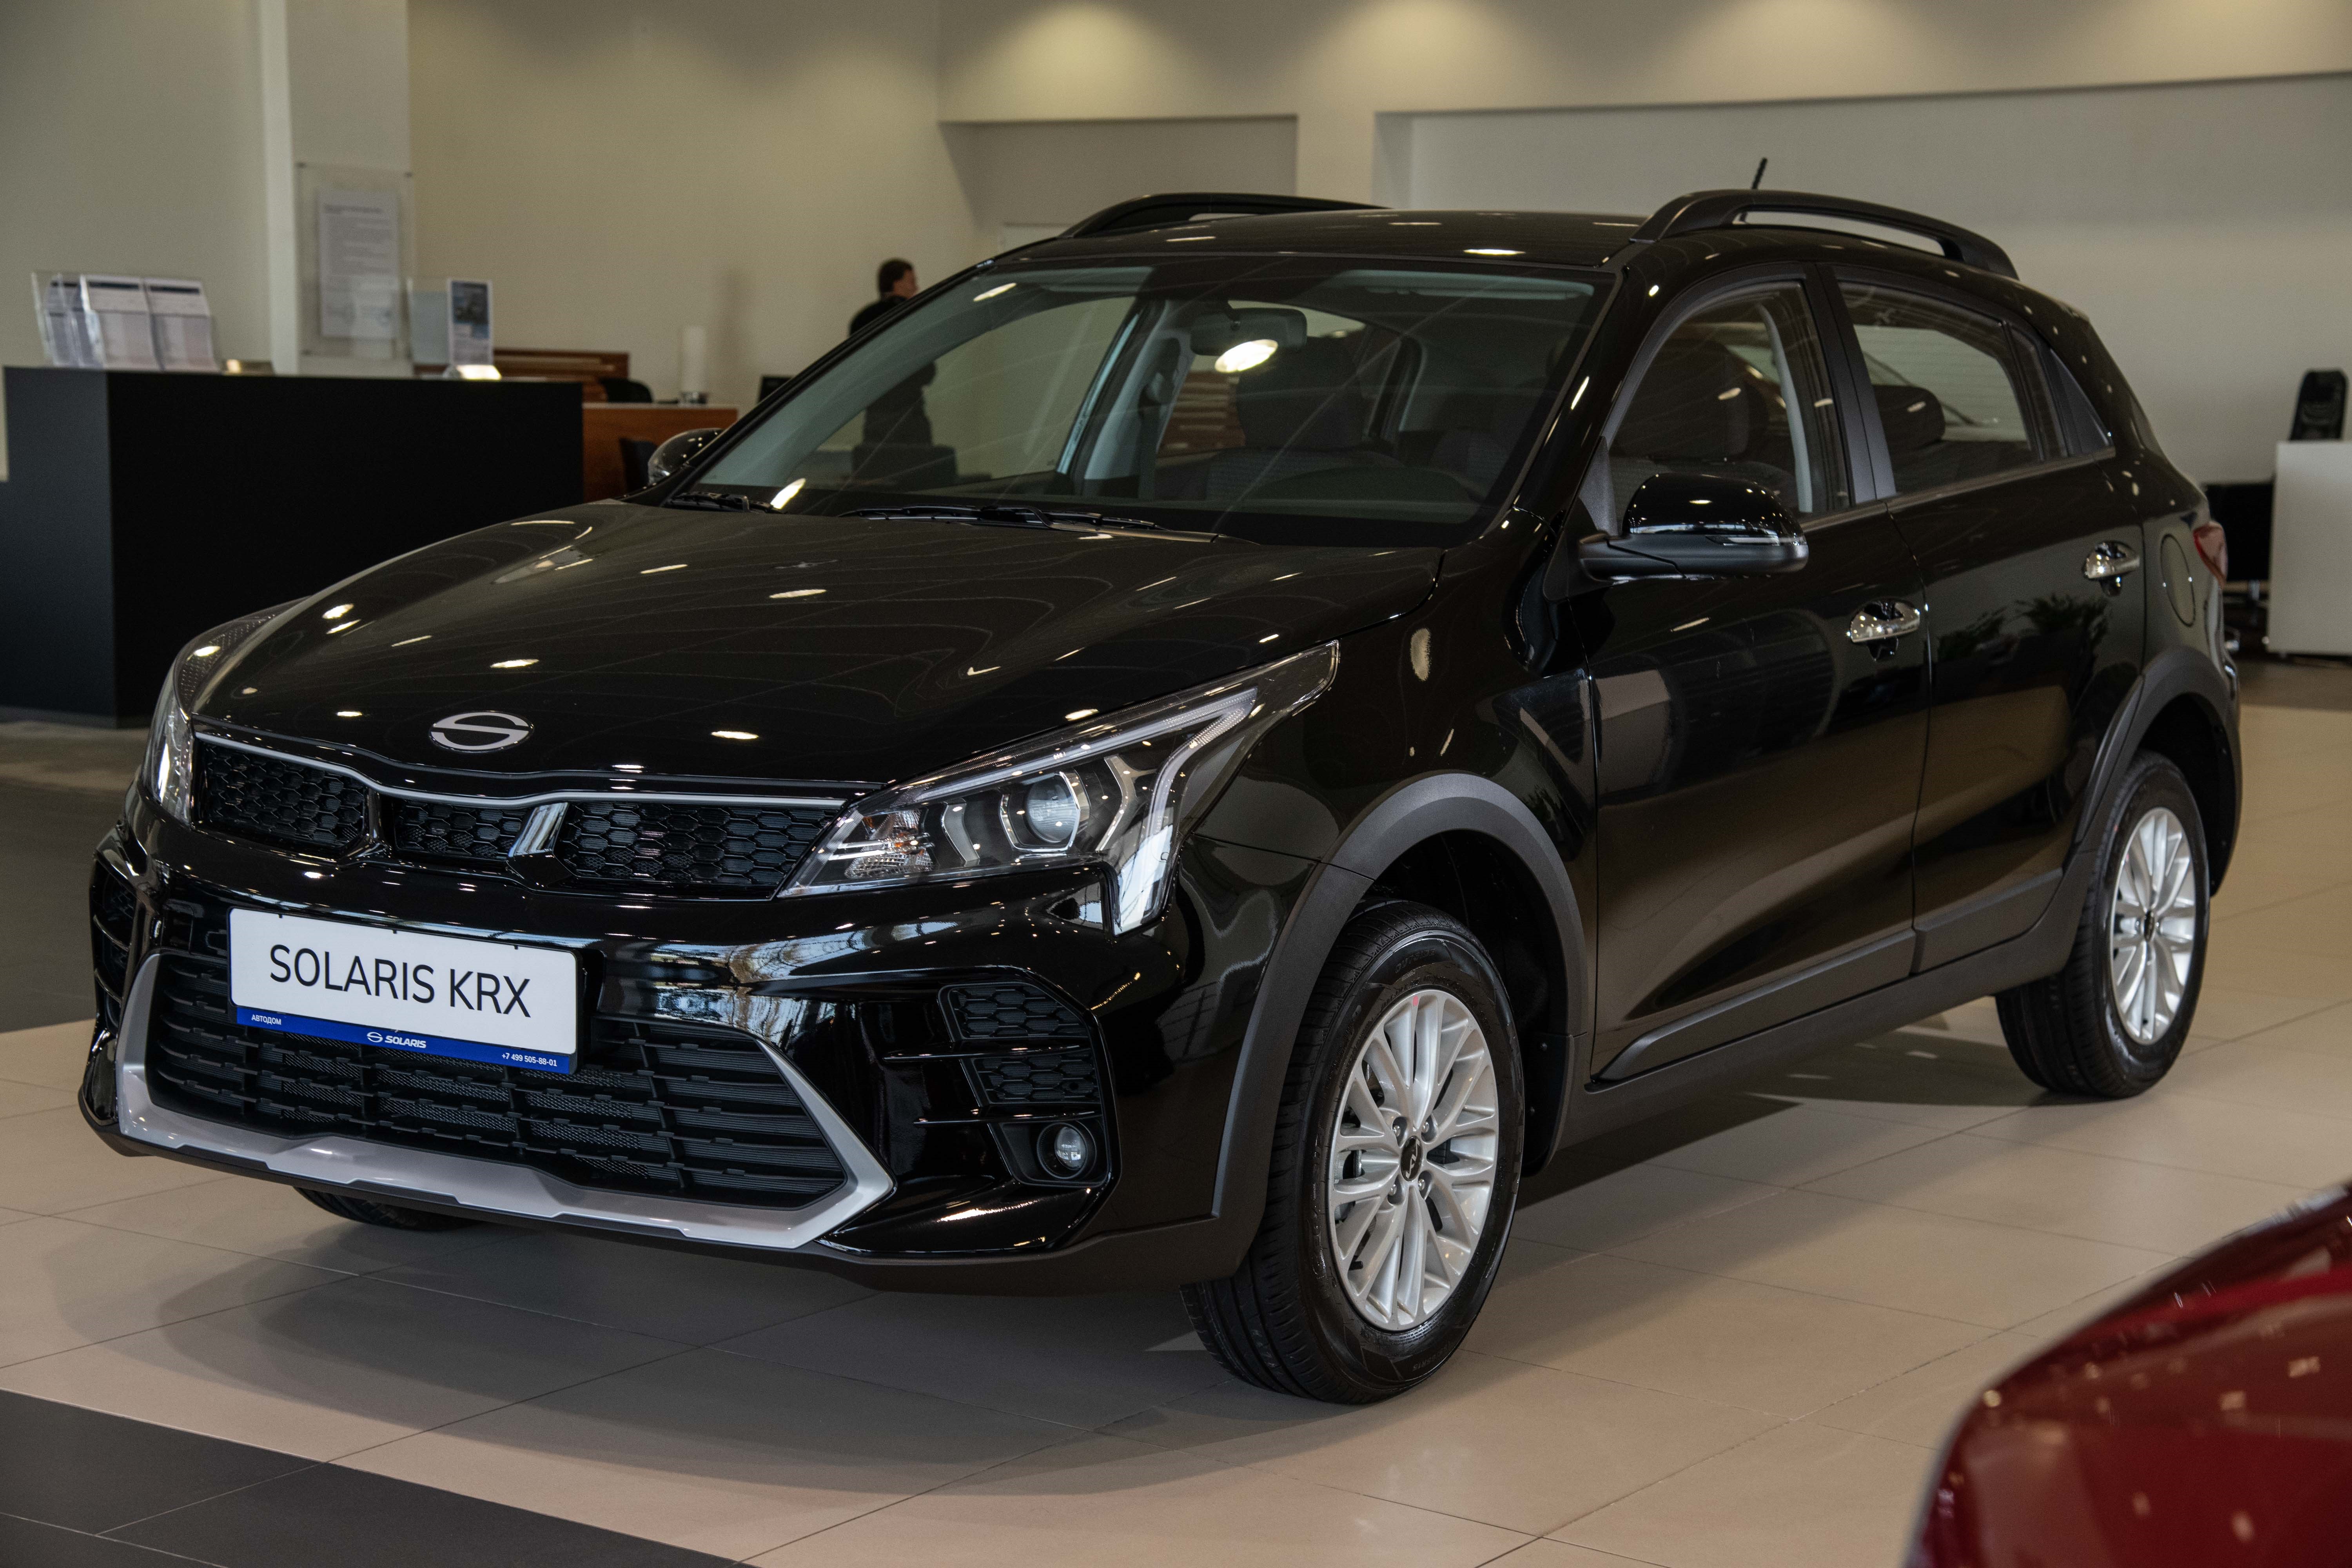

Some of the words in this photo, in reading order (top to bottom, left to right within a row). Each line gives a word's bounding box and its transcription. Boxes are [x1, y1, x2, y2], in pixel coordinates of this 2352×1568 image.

[270, 944, 434, 1004] SOLARIS
[450, 969, 531, 1017] KRX
[251, 1014, 281, 1025] АВТОДОМ
[385, 1035, 426, 1049] SOLARIS
[524, 1055, 557, 1067] 505-88-01
